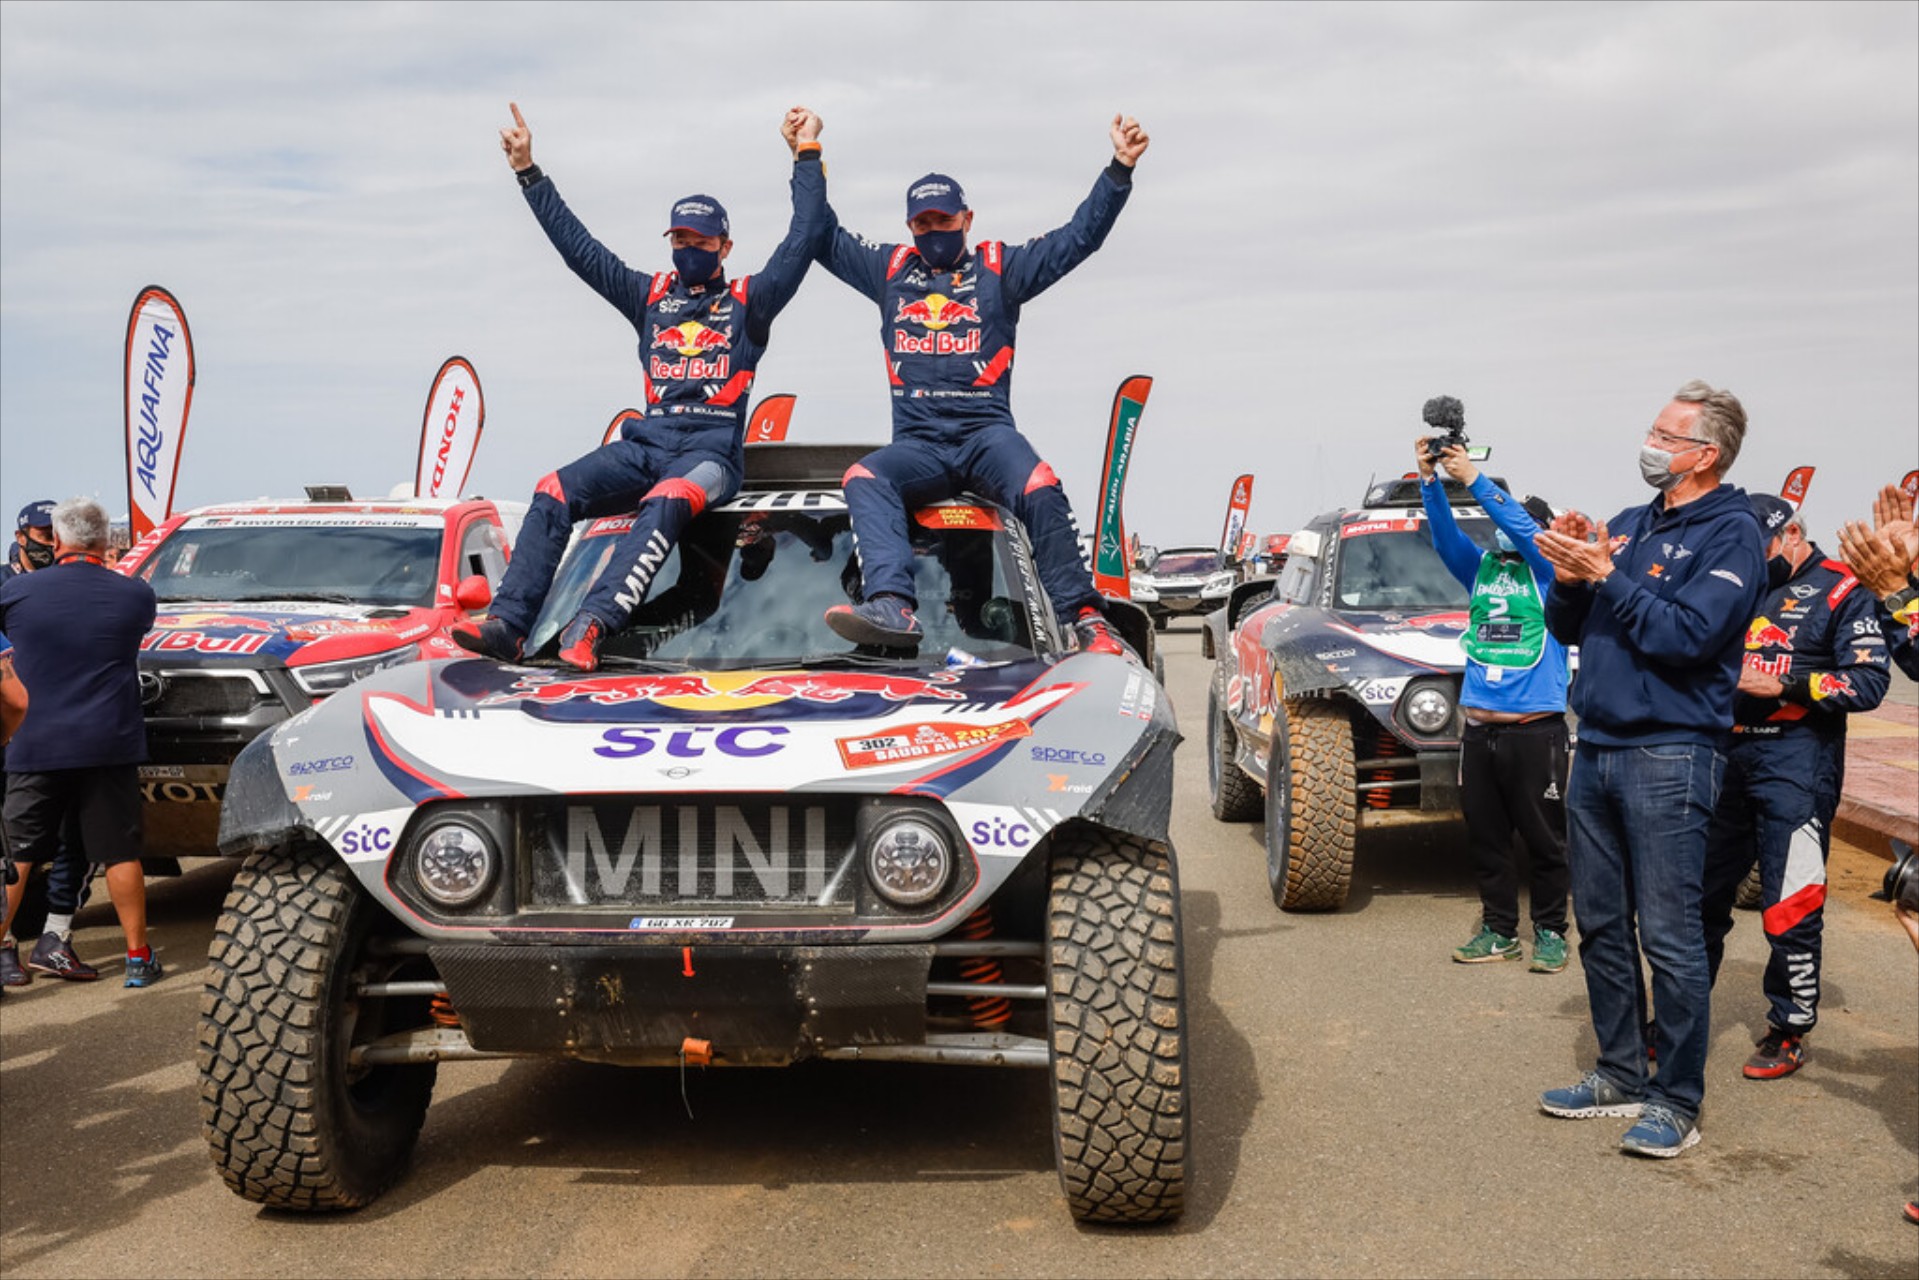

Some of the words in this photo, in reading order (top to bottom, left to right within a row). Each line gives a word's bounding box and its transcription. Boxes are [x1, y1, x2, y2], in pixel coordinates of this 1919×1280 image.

[894, 329, 935, 353] Red
[936, 328, 981, 354] Bull
[650, 355, 688, 379] Red
[688, 354, 730, 379] Bull
[136, 323, 175, 499] AQUAFINA
[1117, 416, 1137, 475] ARABIA
[1346, 520, 1390, 534] MOTUL
[614, 529, 670, 614] MINI
[1487, 597, 1511, 622] 2
[156, 631, 272, 654] Bull
[1750, 653, 1792, 677] Bull
[1365, 684, 1397, 700] stc
[593, 726, 791, 758] stc
[859, 737, 898, 750] 302
[874, 745, 930, 761] SAUDI
[933, 734, 1001, 753] ARABIA
[287, 755, 354, 775] sparco
[1031, 746, 1106, 765] sparco
[341, 824, 391, 854] stc
[972, 816, 1031, 848] stc
[566, 805, 826, 897] MINI
[700, 918, 729, 927] 707
[1787, 952, 1818, 1025] MINI
